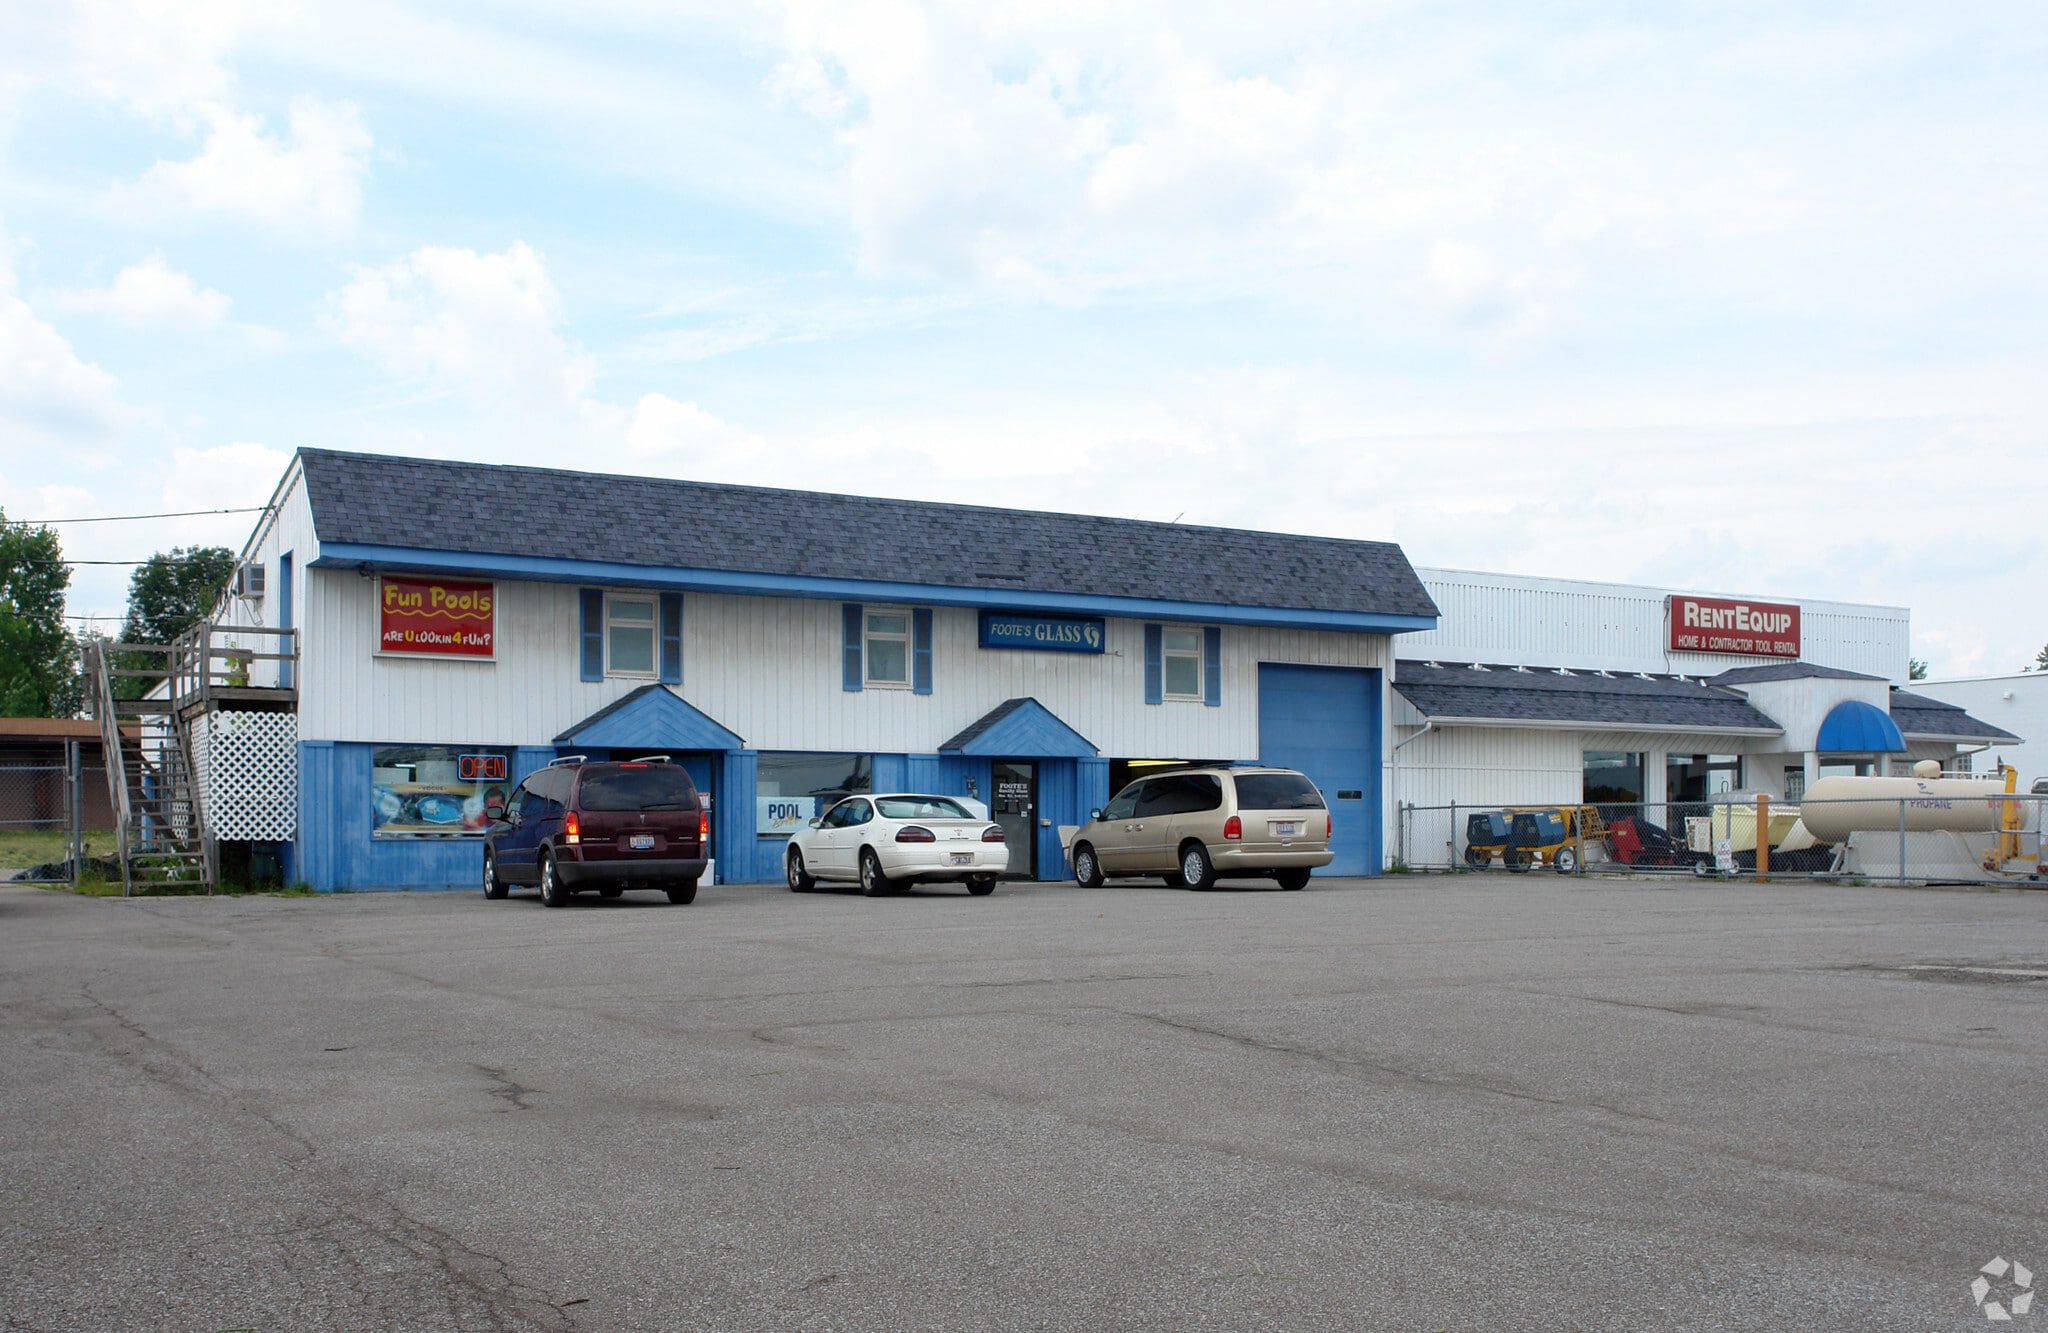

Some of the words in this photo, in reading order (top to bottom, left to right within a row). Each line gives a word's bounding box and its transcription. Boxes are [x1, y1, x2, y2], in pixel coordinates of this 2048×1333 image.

[384, 585, 422, 607] Fun
[429, 586, 491, 611] Pools
[383, 630, 404, 642] ARE
[404, 629, 415, 643] U
[415, 631, 452, 644] LOOKIN
[452, 631, 462, 645] 4
[463, 633, 491, 646] FUN?
[991, 623, 1032, 637] FOOTE'S
[1034, 624, 1081, 643] GLASS
[1678, 635, 1699, 648] HOME
[1709, 637, 1753, 651] CONTRACTOR
[1755, 640, 1772, 653] TOOL
[1773, 641, 1797, 655] RENTAL
[461, 756, 505, 778] OPEN
[768, 803, 803, 820] POOL
[1910, 799, 1953, 810] PROPANE
